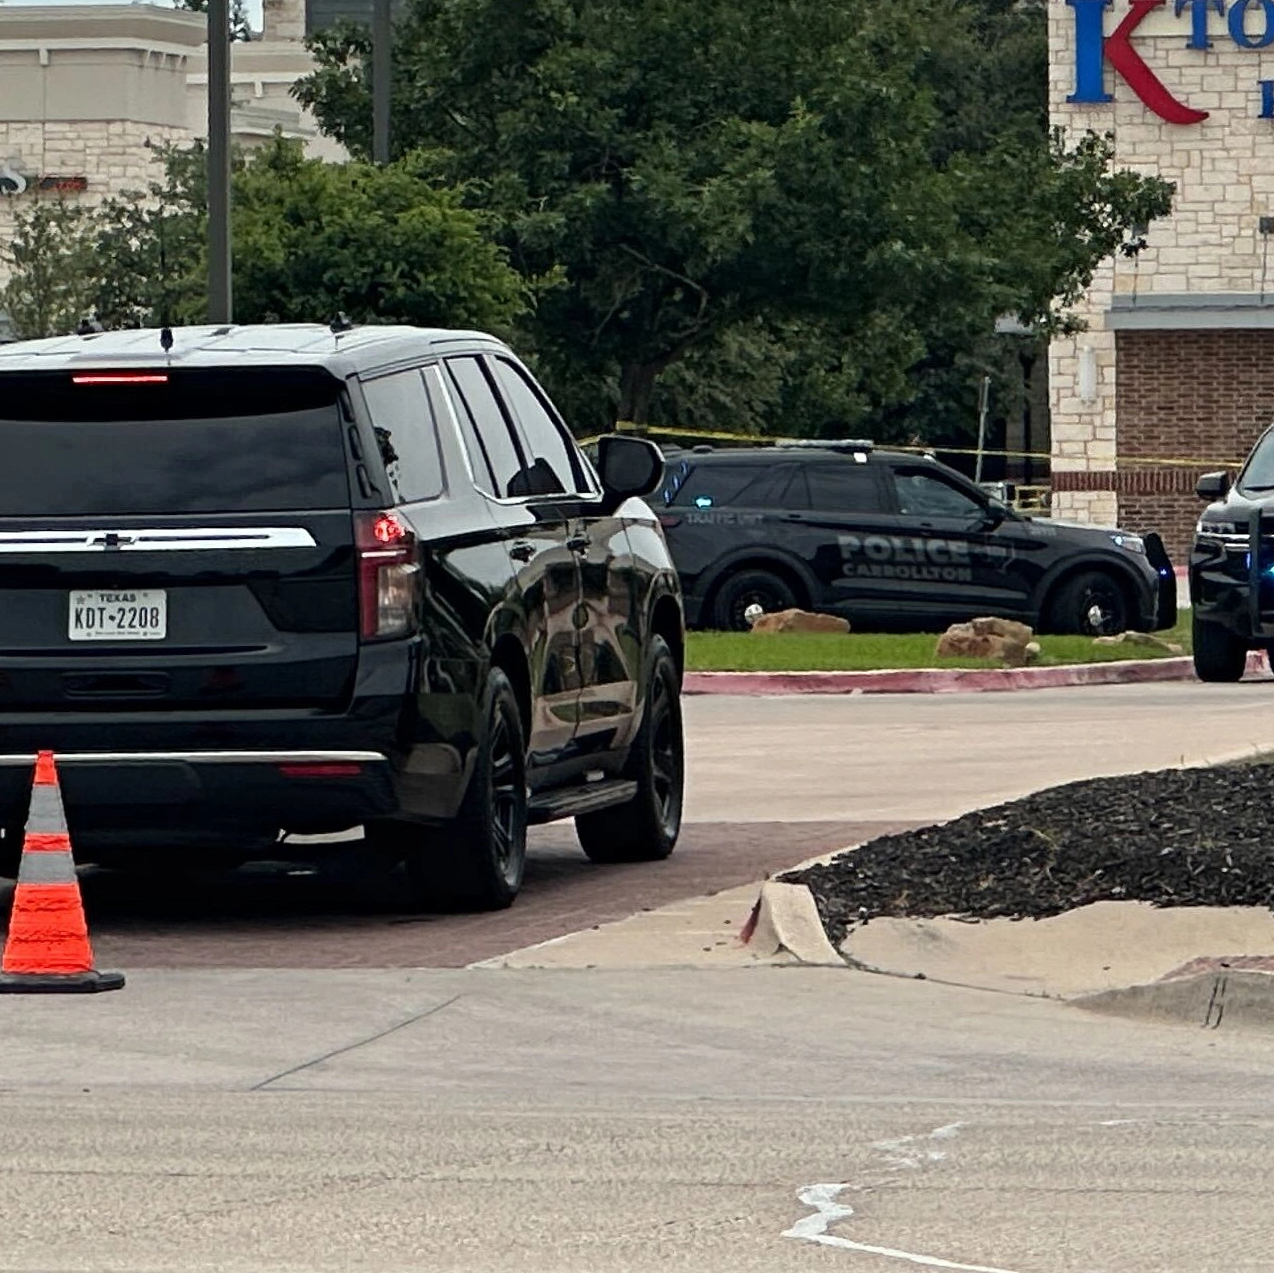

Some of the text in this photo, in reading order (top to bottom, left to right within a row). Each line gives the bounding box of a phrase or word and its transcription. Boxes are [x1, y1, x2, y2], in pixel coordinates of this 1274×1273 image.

[838, 535, 971, 563] POLICE
[842, 563, 972, 581] CARROLLTON
[99, 593, 136, 602] TEXAS
